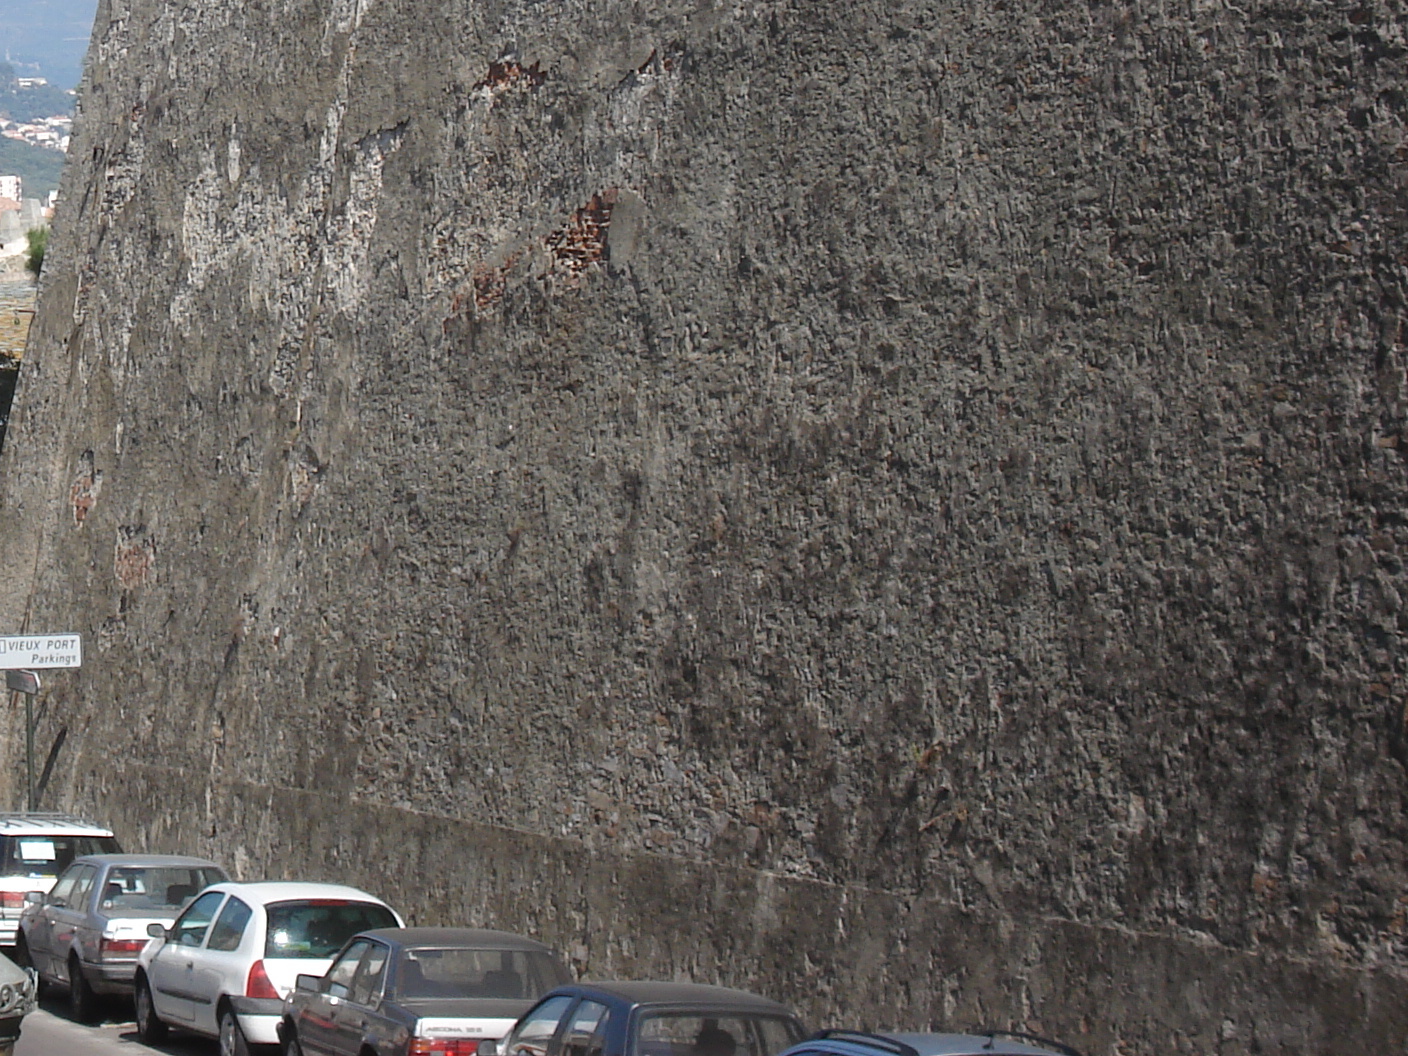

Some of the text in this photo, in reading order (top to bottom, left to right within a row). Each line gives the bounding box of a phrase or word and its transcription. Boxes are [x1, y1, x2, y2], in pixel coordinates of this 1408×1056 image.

[8, 640, 41, 651] VIEUX
[46, 639, 76, 650] PORT
[31, 653, 77, 665] Parkings
